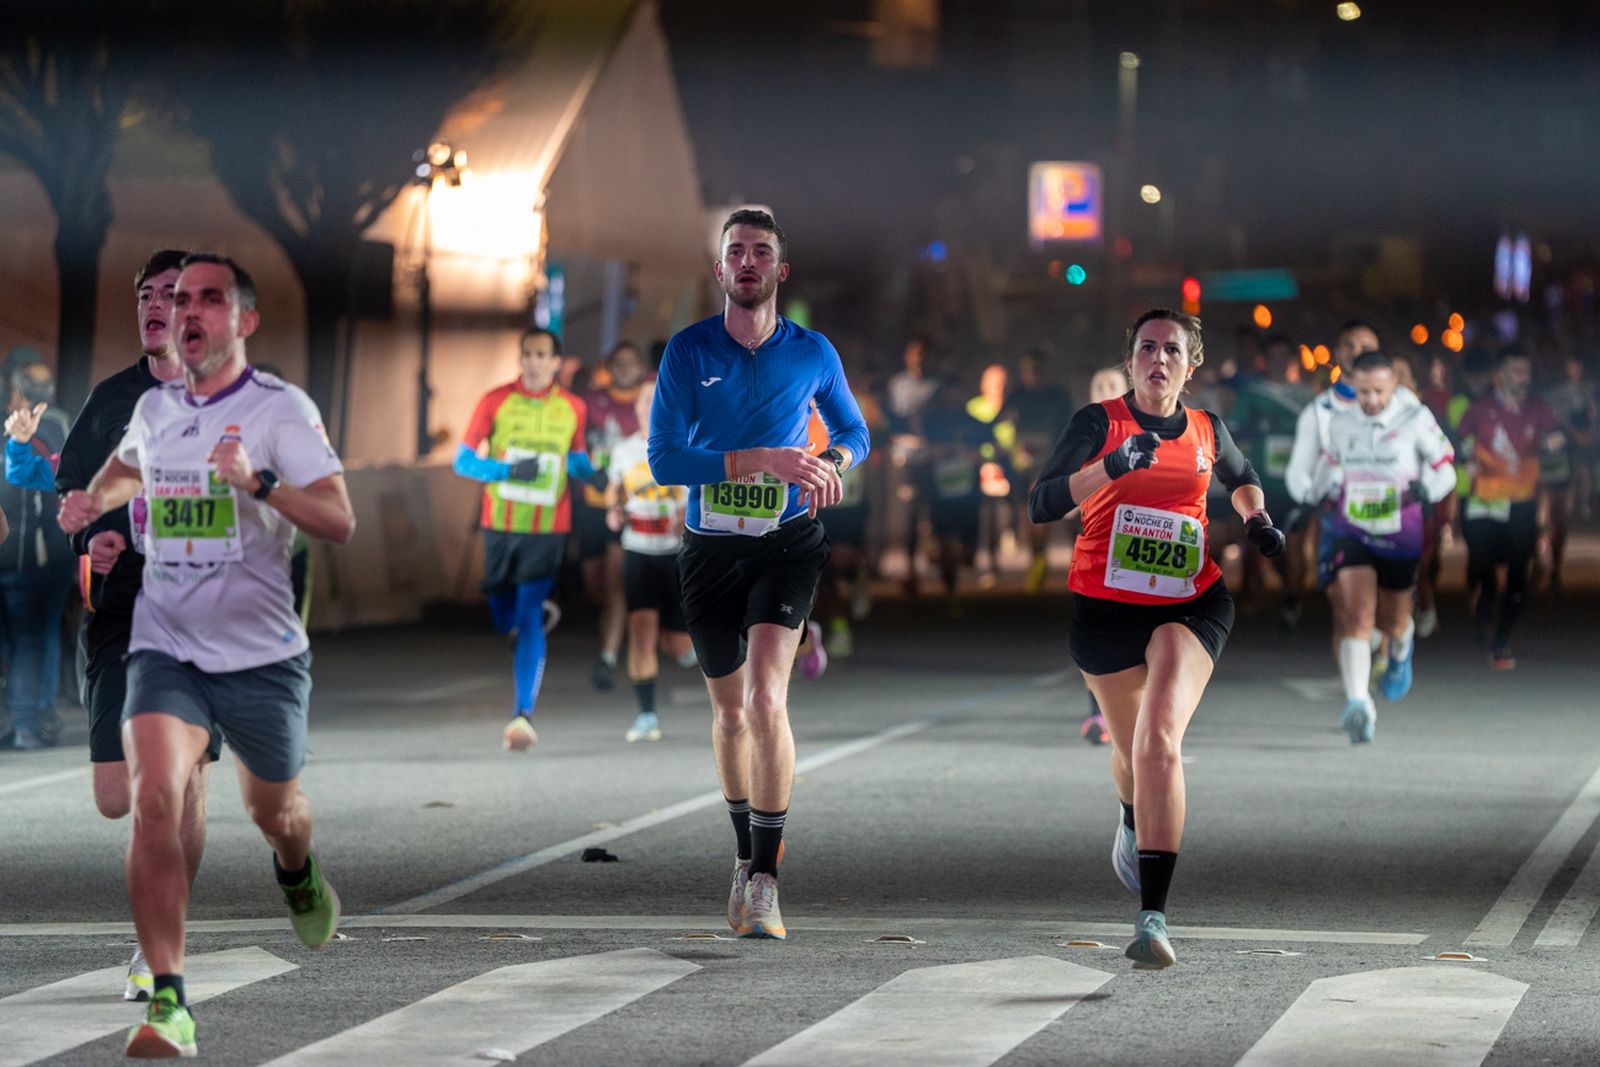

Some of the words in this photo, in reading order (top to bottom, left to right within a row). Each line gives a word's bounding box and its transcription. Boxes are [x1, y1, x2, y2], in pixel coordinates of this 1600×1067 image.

[155, 485, 172, 496] SAN
[711, 482, 777, 510] 13990
[163, 498, 216, 528] 3417
[1134, 516, 1163, 527] NOCHE
[1163, 521, 1174, 529] DE
[1122, 524, 1140, 535] SAN
[1142, 527, 1173, 540] ANTÓN
[1126, 537, 1187, 569] 4528
